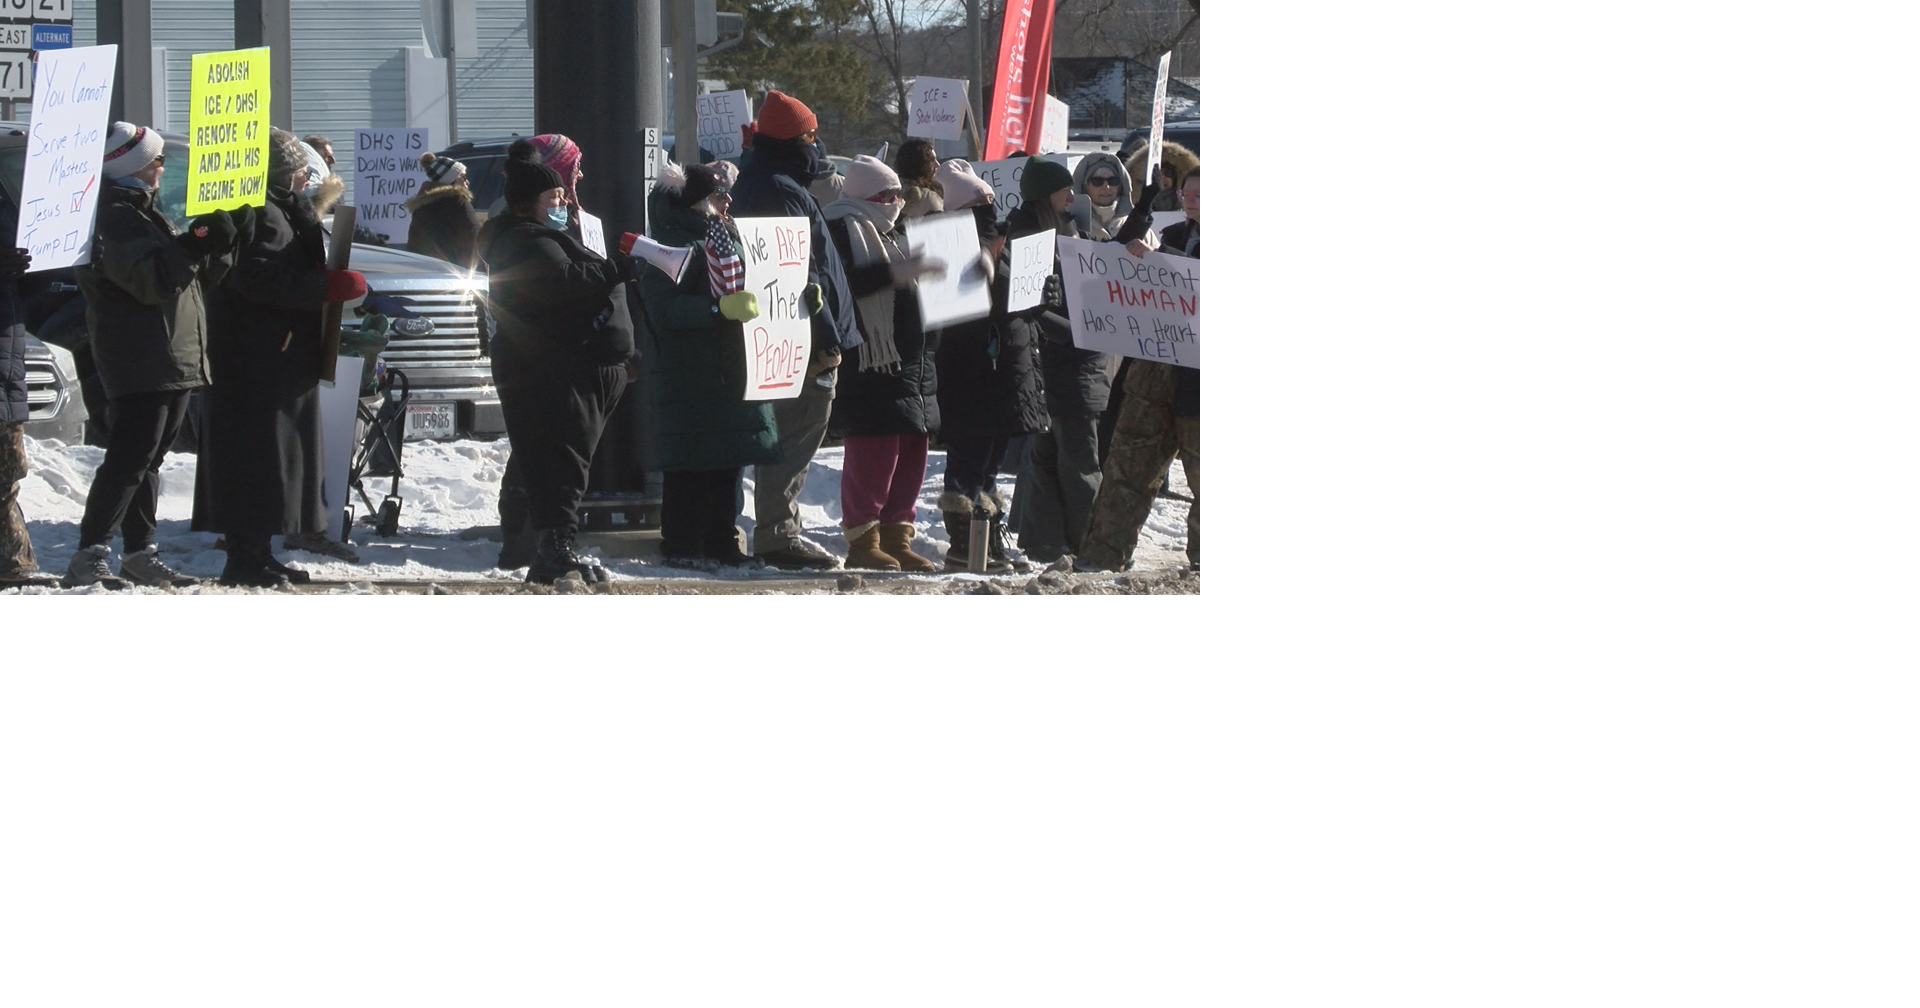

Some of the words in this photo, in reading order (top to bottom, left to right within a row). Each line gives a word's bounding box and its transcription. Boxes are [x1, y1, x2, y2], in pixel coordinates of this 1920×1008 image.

[0, 27, 26, 45] EAST
[35, 32, 70, 44] ALTERNATE
[207, 61, 249, 84] ABOLISH
[41, 60, 66, 113] You
[71, 62, 107, 103] Cannot
[923, 88, 940, 104] ICE
[205, 94, 221, 115] ICE
[236, 89, 258, 114] DHS!
[697, 95, 734, 116] ENEE
[916, 108, 931, 125] State
[932, 107, 956, 123] Violence
[1005, 93, 1031, 158] her
[32, 122, 67, 156] Serve
[73, 123, 98, 150] two
[197, 122, 237, 146] REMOVE
[245, 120, 258, 141] 47
[360, 132, 394, 151] DHS
[405, 133, 422, 150] IS
[199, 151, 221, 174] AND
[224, 149, 241, 171] ALL
[244, 147, 260, 168] HIS
[357, 156, 396, 173] DOING
[198, 179, 234, 203] REGIME
[239, 171, 265, 197] NOW!
[364, 175, 416, 197] TRUMP
[981, 167, 1003, 188] CE
[26, 197, 61, 227] Jesus
[360, 203, 407, 221] WANTS
[23, 228, 61, 259] Trump
[743, 227, 769, 266] We
[775, 226, 806, 261] ARE
[1023, 241, 1043, 270] DUE
[1118, 257, 1200, 292] Decent
[763, 278, 797, 323] The
[1106, 280, 1197, 317] HUMAN
[406, 318, 428, 331] Ford
[1128, 315, 1141, 336] A
[1153, 317, 1198, 344] Heart
[753, 326, 803, 383] PEOPLE
[1137, 338, 1180, 364] ICE!
[412, 412, 450, 429] UU5986
